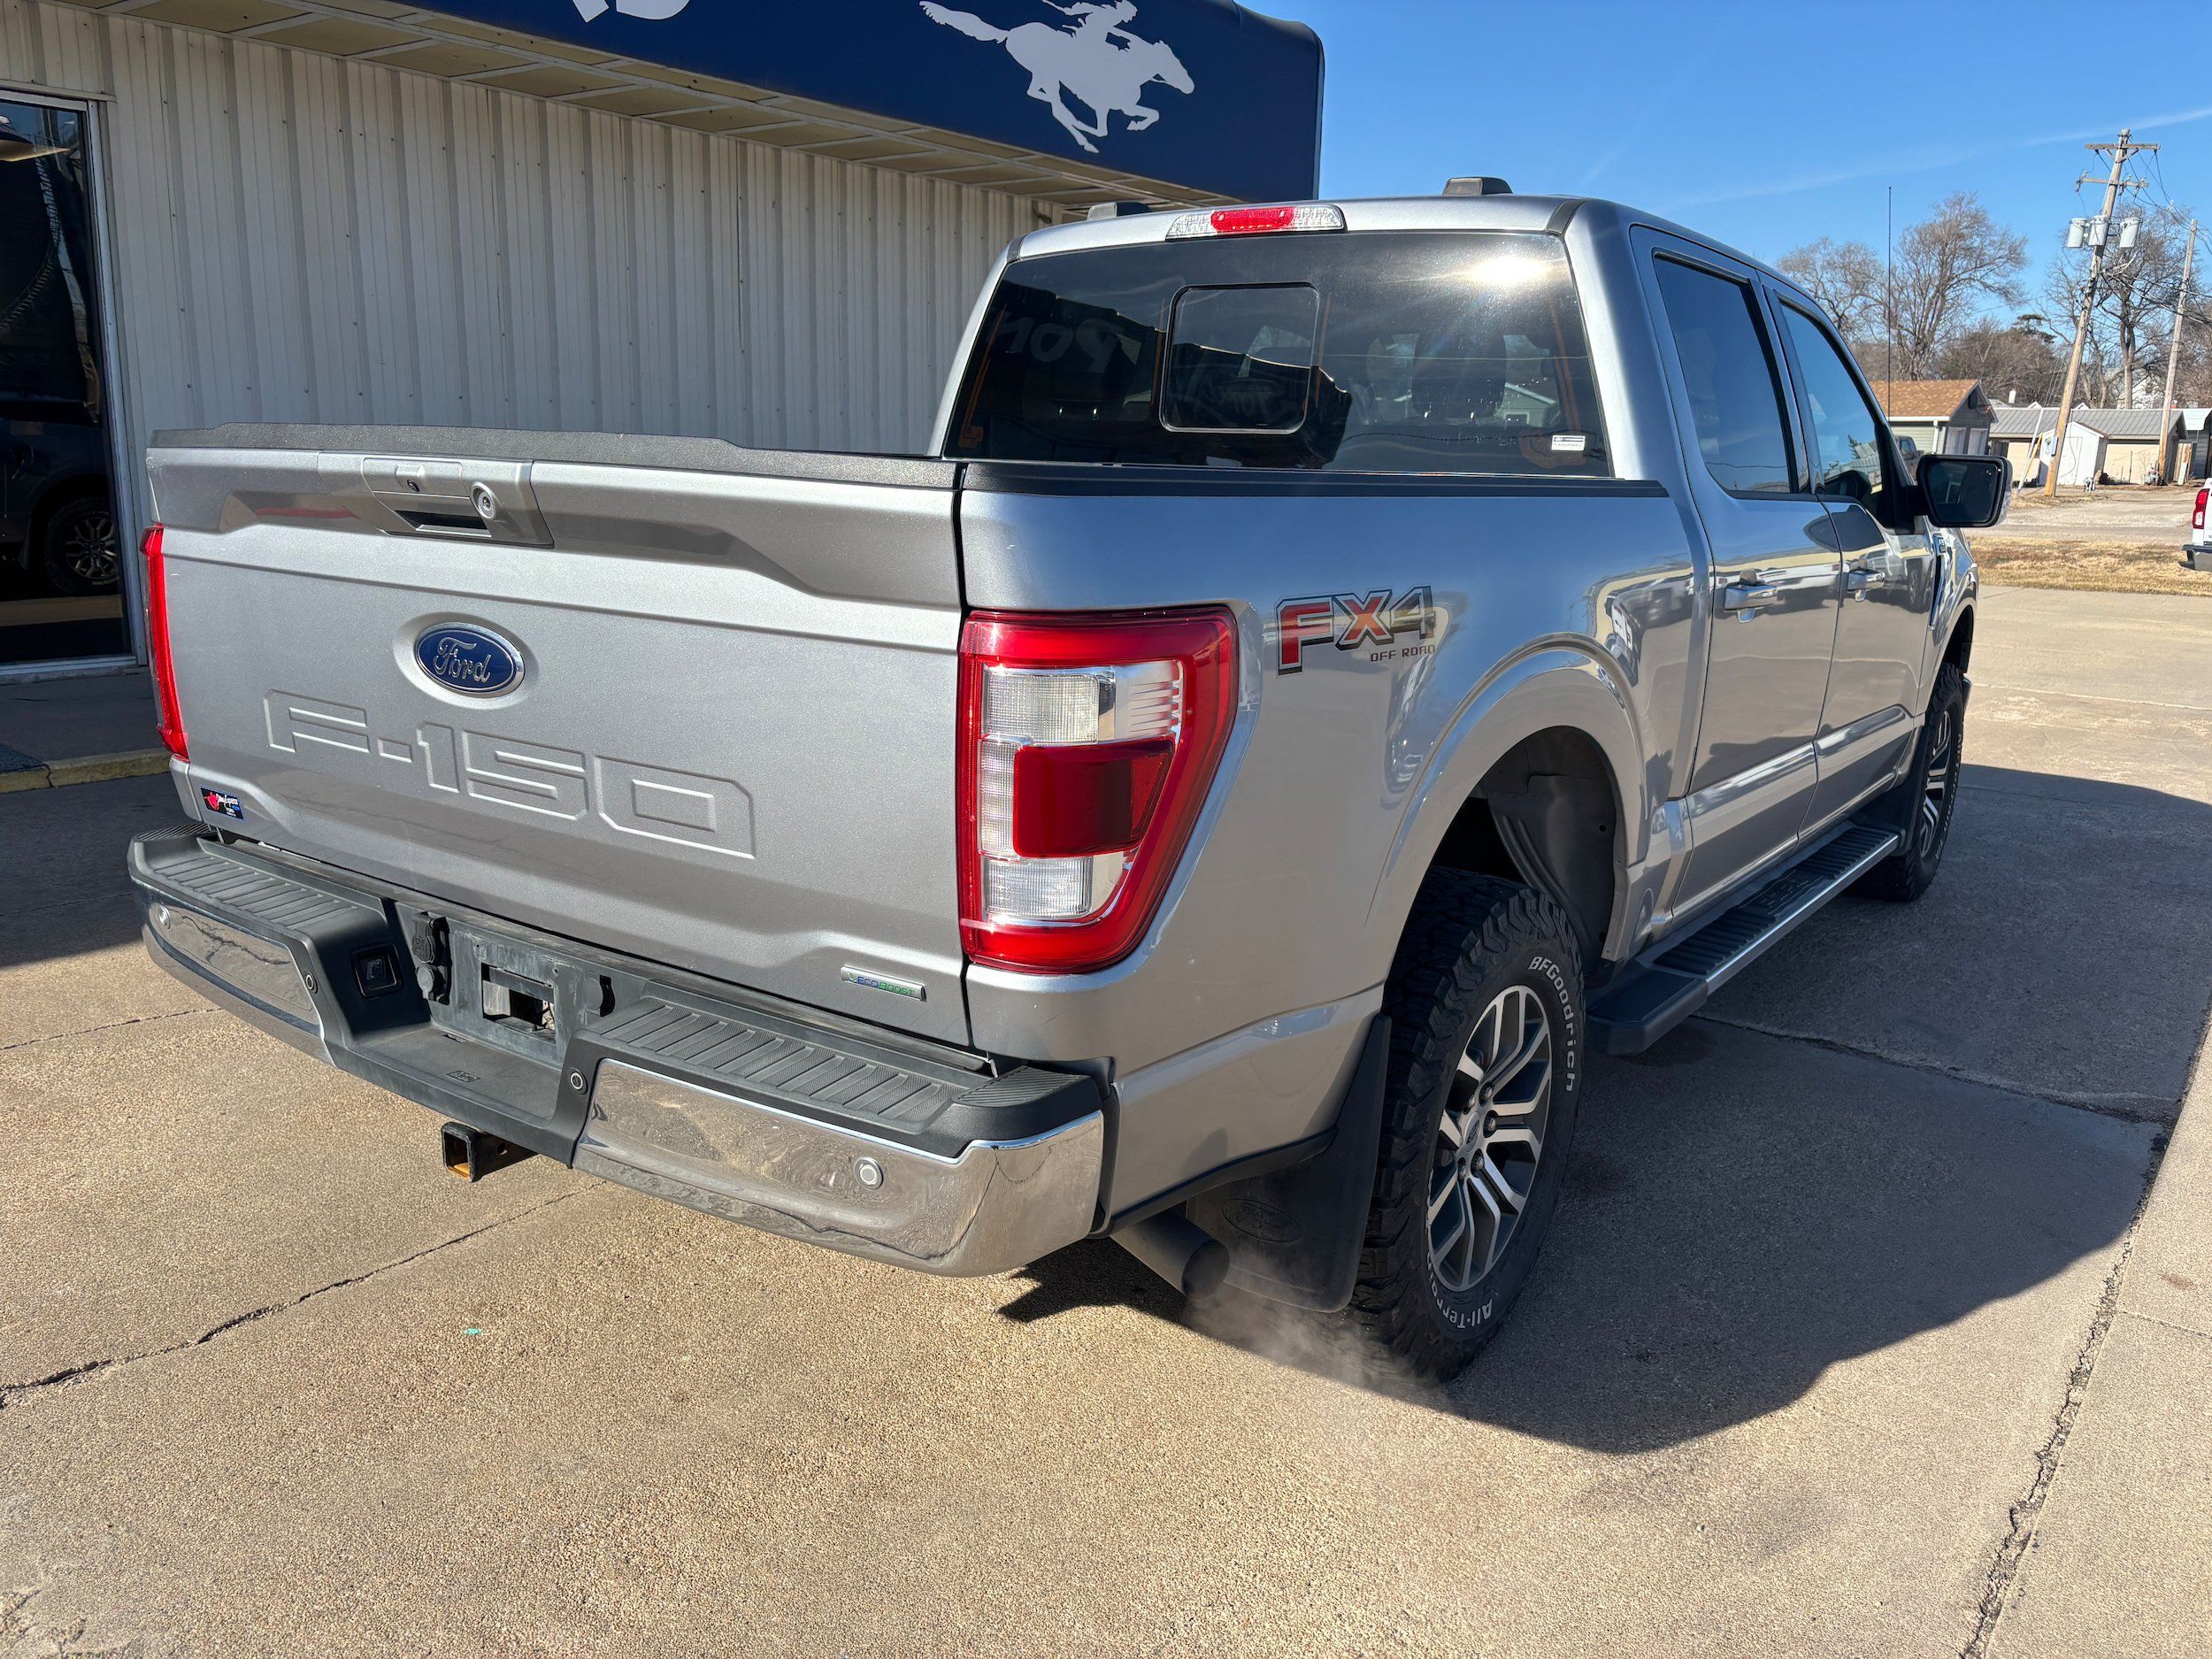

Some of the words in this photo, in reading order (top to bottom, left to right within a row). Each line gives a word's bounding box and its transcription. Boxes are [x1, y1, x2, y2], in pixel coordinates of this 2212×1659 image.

[433, 636, 492, 683] Ford
[1276, 585, 1435, 675] FX4
[1370, 649, 1397, 663] OFF
[1402, 643, 1436, 659] ROAD
[264, 689, 756, 859] F-150
[1528, 956, 1577, 1092] BFGoodrich
